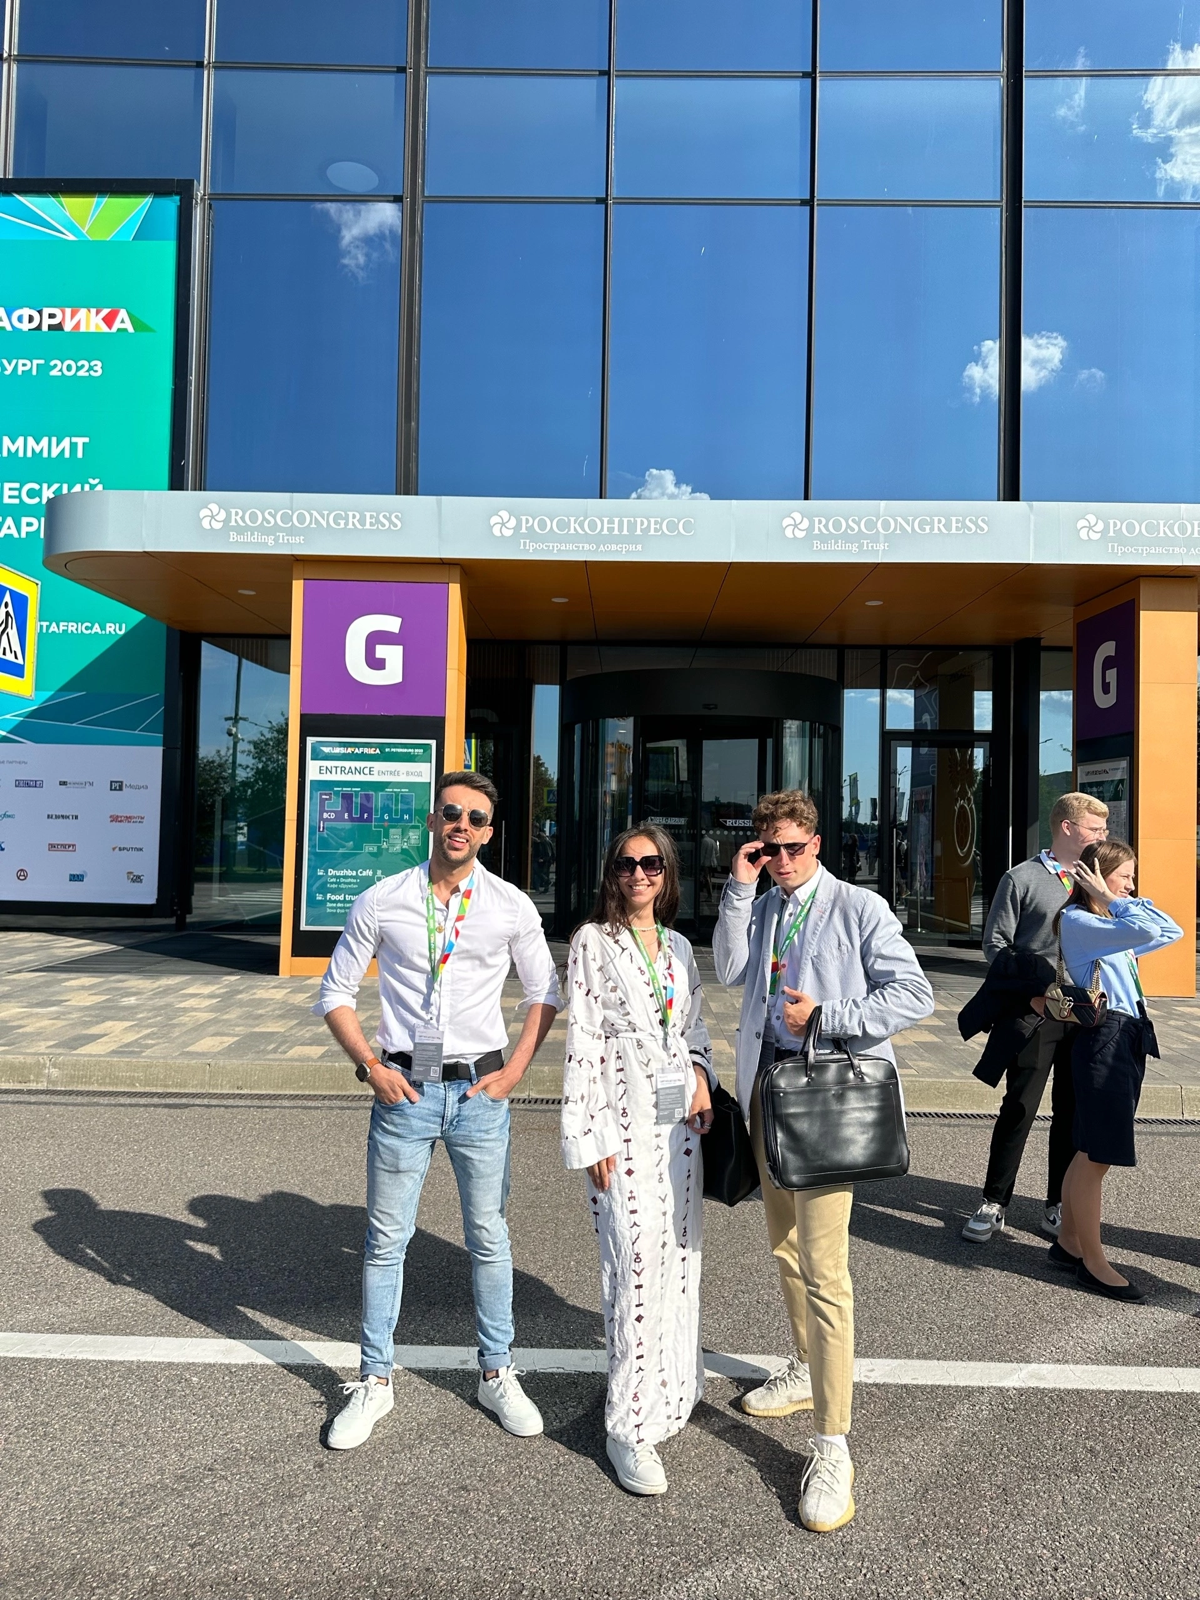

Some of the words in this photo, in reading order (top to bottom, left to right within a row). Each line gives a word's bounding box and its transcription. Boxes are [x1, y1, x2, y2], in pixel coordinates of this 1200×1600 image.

[0, 307, 134, 333] АФРИКА
[0, 359, 45, 376] УРГ
[49, 359, 103, 377] 2023
[0, 435, 90, 459] ММИТ
[0, 516, 45, 539] АР
[229, 508, 402, 531] ROSCONGRESS
[519, 515, 695, 536] РОСКОНГРЕСС
[812, 515, 989, 535] ROSCONGRESS
[229, 531, 275, 546] Building
[276, 533, 304, 544] Trust
[519, 539, 596, 553] Пространство
[598, 541, 642, 553] доверия
[812, 539, 859, 554] Building
[860, 540, 889, 551] Trust
[1107, 542, 1187, 557] Пространство
[345, 613, 404, 686] G
[1092, 640, 1118, 709] G
[318, 765, 375, 777] ENTRANCE
[377, 768, 401, 778] ENTRÉE
[405, 770, 423, 778] ВХОД
[328, 868, 356, 876] Druzhba
[358, 869, 373, 877] Café
